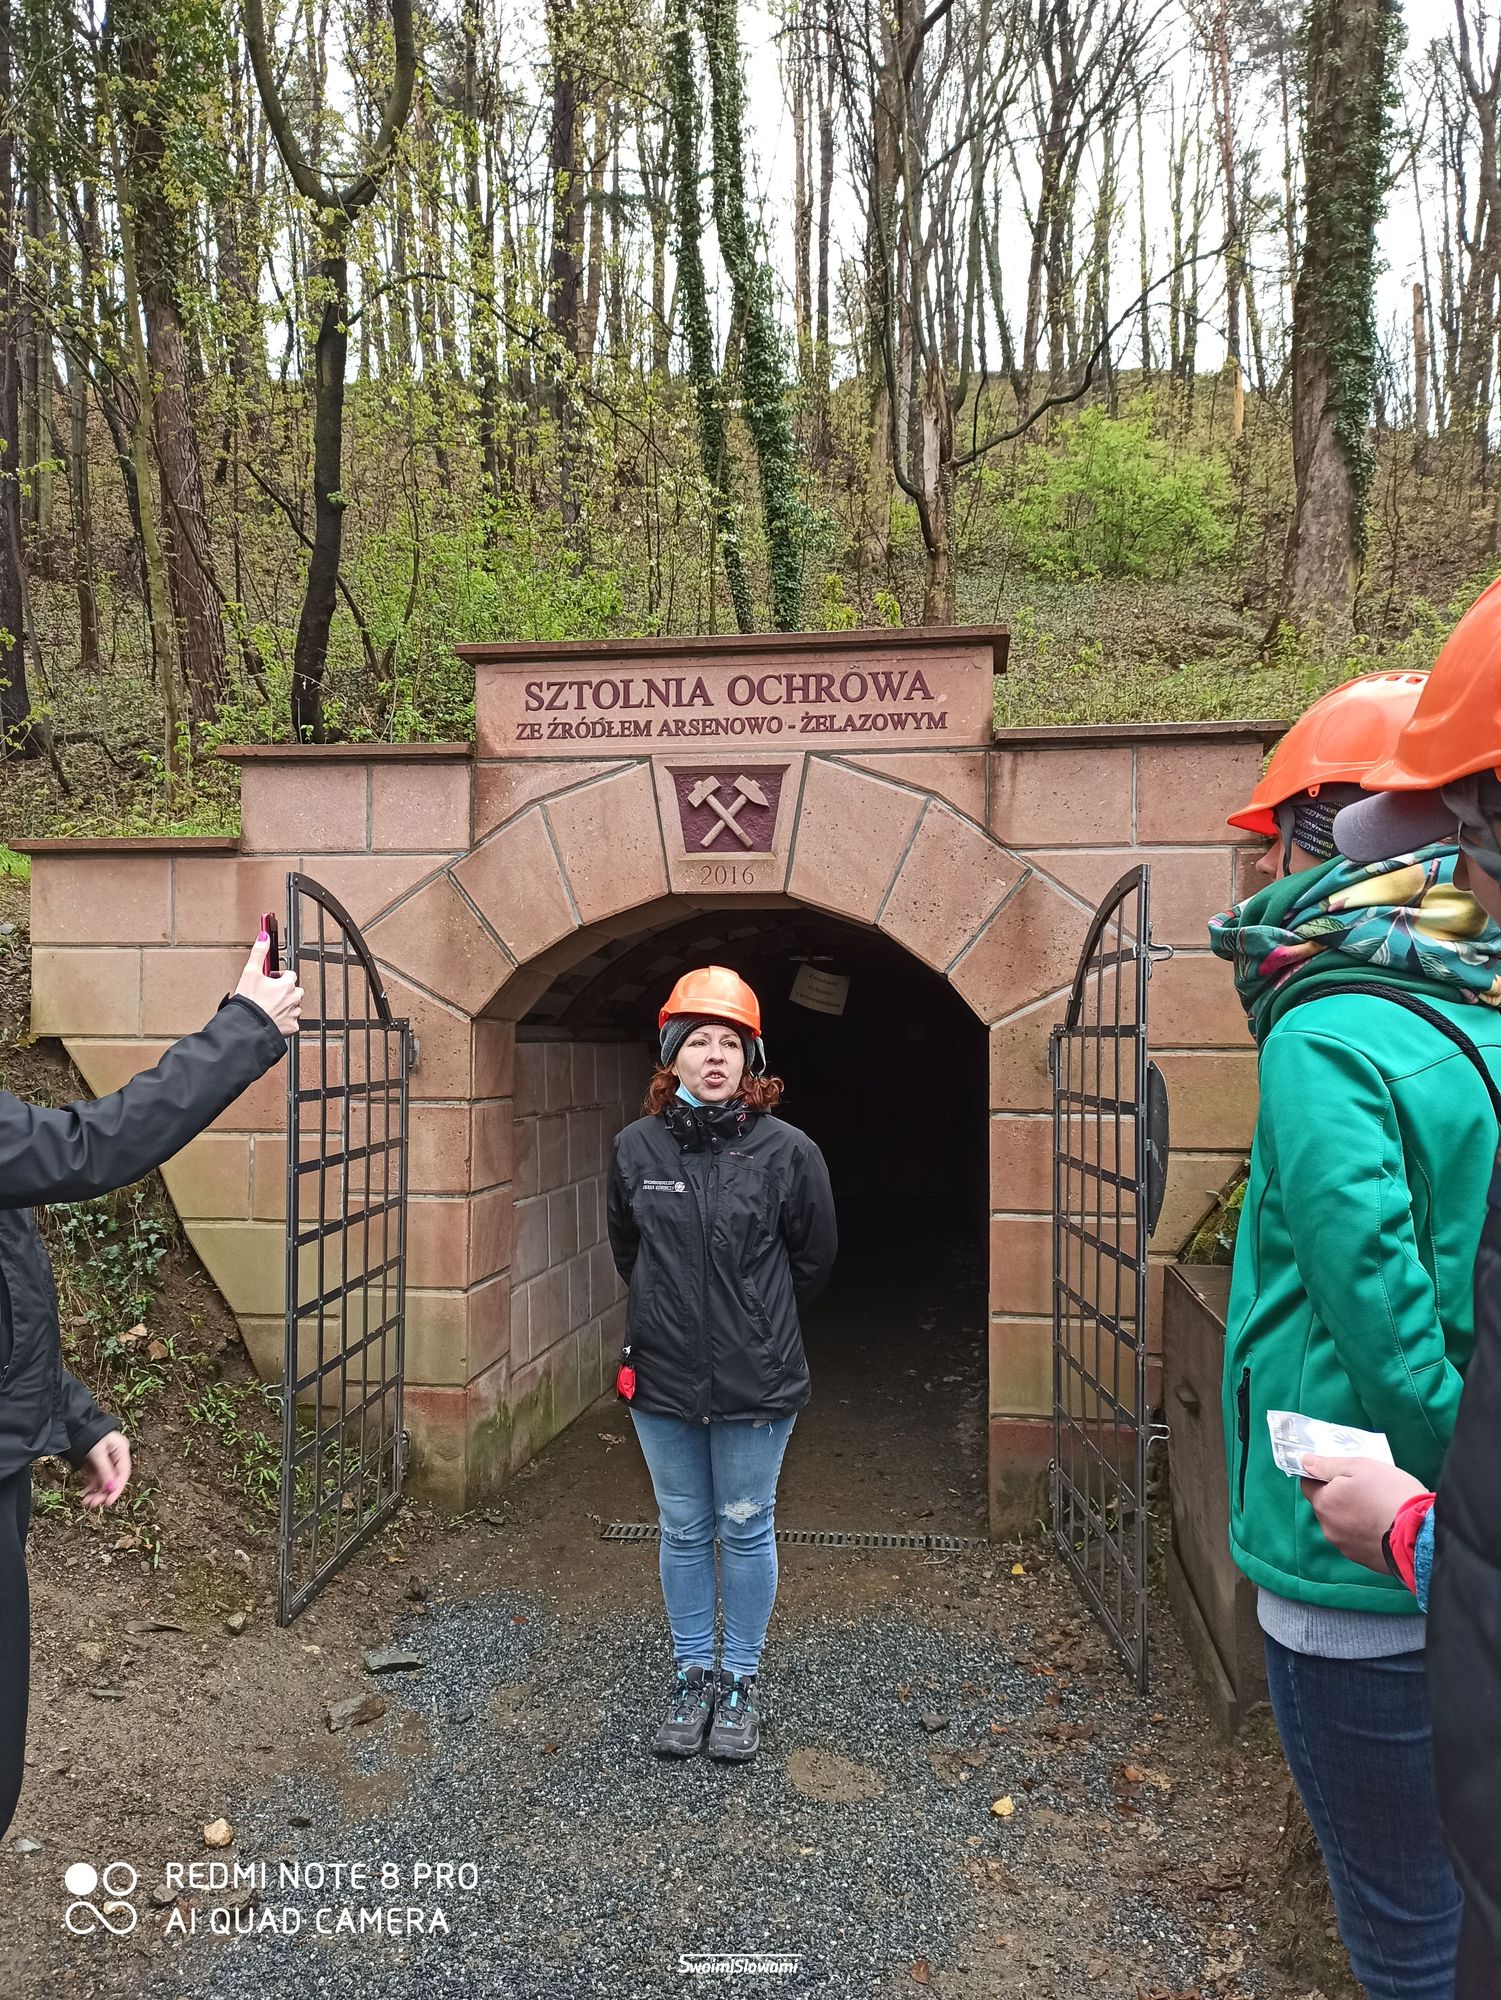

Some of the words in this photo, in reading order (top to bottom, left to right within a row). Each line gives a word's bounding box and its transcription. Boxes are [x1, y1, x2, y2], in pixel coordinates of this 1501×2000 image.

[524, 675, 715, 712] SZTOLNIA
[515, 722, 543, 741] ZE
[546, 715, 653, 740] ŹRÓDŁEM
[656, 716, 784, 738] ARSENOWO
[799, 710, 949, 734] ŻELAZOWYM
[700, 865, 755, 886] 2016
